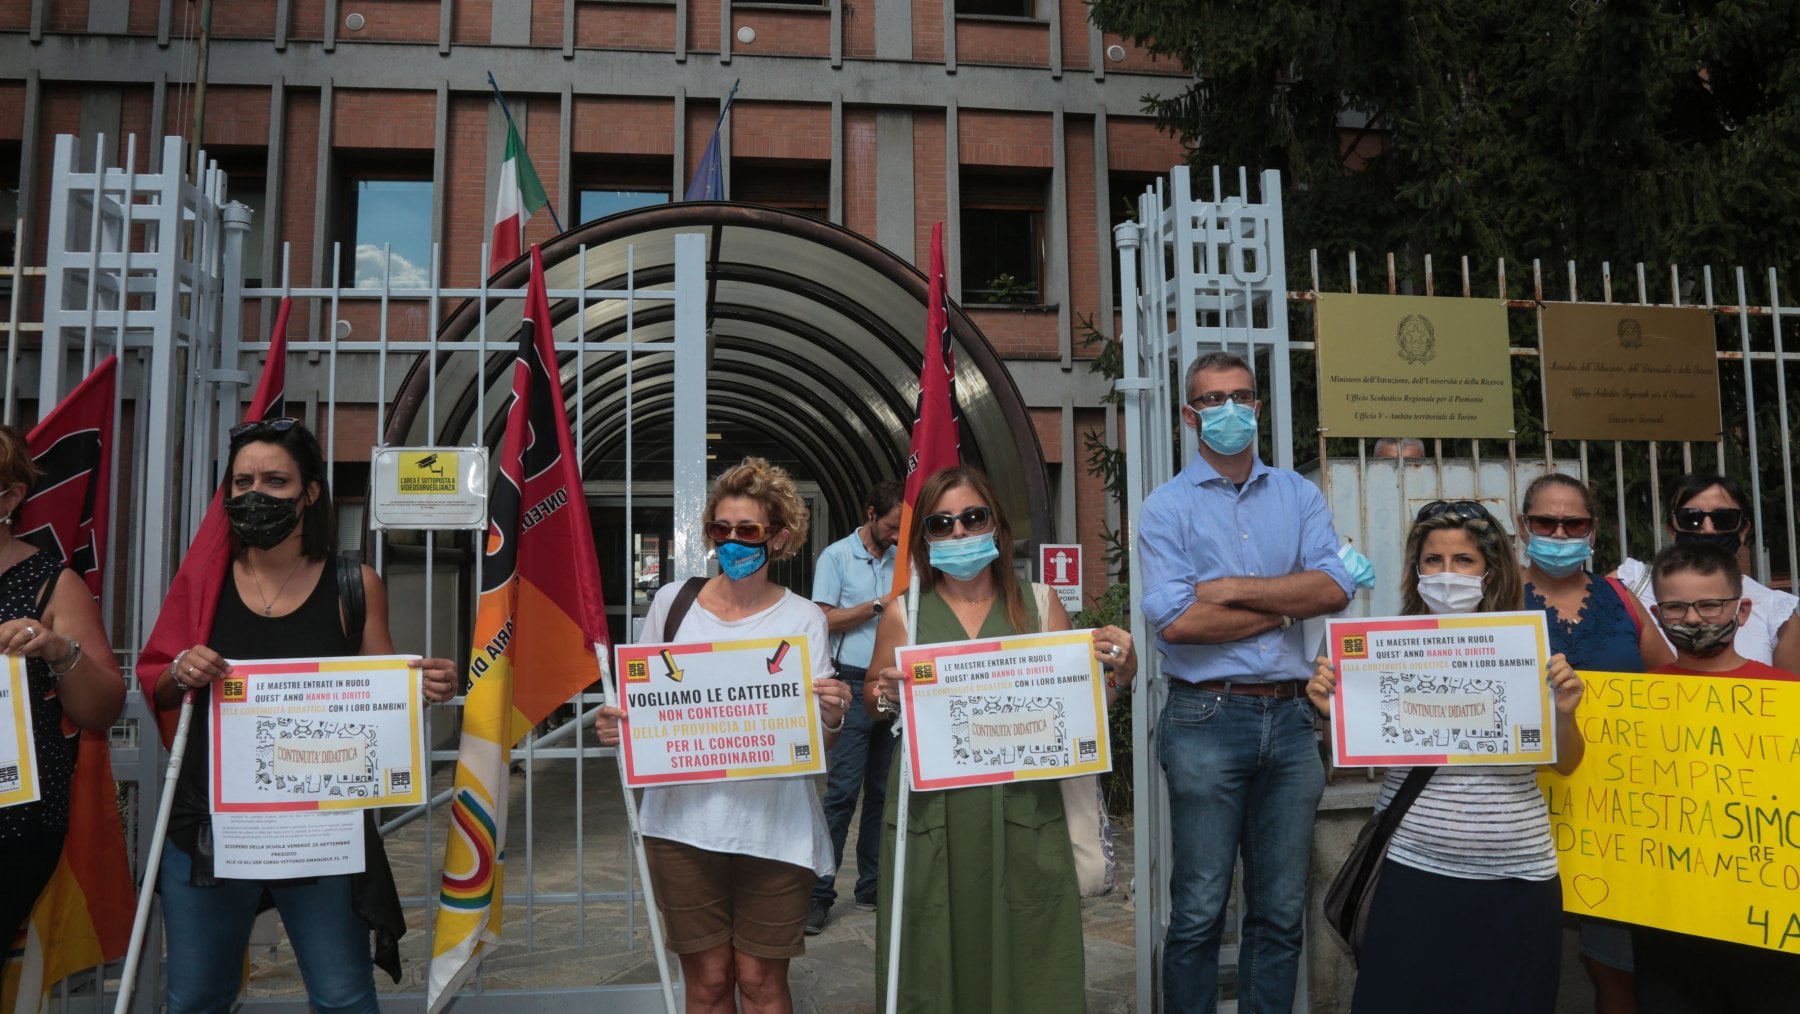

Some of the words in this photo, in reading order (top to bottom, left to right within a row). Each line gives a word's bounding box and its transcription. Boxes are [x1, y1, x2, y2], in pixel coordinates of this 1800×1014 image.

[1346, 394, 1368, 403] Ufficio
[1370, 394, 1401, 402] Scolastico
[1403, 395, 1434, 403] Regionale
[1355, 412, 1377, 421] Ufficio
[1387, 638, 1420, 646] MAESTRE
[1423, 636, 1454, 644] ENTRATE
[1457, 636, 1466, 644] IN
[1468, 635, 1494, 643] RUOLO
[1376, 650, 1401, 659] QUEST'
[1404, 650, 1424, 658] ANNO
[1427, 649, 1452, 657] HANNO
[1455, 648, 1462, 656] IL
[1465, 647, 1495, 656] DIRITTO
[955, 662, 985, 671] MAESTRE
[988, 658, 1016, 667] ENTRATE
[1029, 654, 1052, 663] RUOLO
[1343, 664, 1360, 672] ALLA
[1410, 661, 1449, 670] DIDATTICA
[1452, 660, 1467, 668] CON
[1475, 659, 1496, 668] LORO
[1499, 658, 1535, 667] BAMBINI!
[945, 674, 968, 683] QUEST'
[971, 672, 989, 680] ANNO
[992, 670, 1015, 678] HANNO
[1026, 666, 1054, 676] DIRITTO
[257, 682, 265, 690] LE
[268, 681, 301, 690] MAESTRE
[303, 680, 333, 688] ENTRATE
[346, 679, 370, 687] RUOLO
[914, 689, 930, 697] ALLA
[976, 683, 1012, 692] DIDATTICA
[1015, 680, 1029, 688] CON
[1037, 677, 1055, 686] LORO
[1057, 674, 1089, 684] BAMBINI!
[342, 691, 370, 700] DIRITTO
[628, 690, 700, 707] VOGLIAMO
[707, 689, 723, 702] LE
[728, 682, 800, 701] CATTEDRE
[1585, 678, 1777, 717] NSEGNARE
[222, 708, 238, 716] ALLA
[288, 705, 326, 714] DIDATTICA
[351, 704, 370, 712] LORO
[373, 702, 407, 711] BAMBINI!
[659, 709, 683, 721] NON
[688, 703, 768, 719] CONTEGGIATE
[1448, 702, 1486, 718] DIDATTICA
[633, 726, 668, 740] DELLA
[673, 722, 739, 736] PROVINCIA
[744, 720, 757, 732] DI
[762, 716, 807, 731] TORINO
[1013, 719, 1047, 736] DIDATTICA
[666, 740, 689, 753] PER
[694, 739, 704, 750] IL
[709, 734, 775, 750] CONCORSO
[1661, 725, 1724, 757] UNA
[321, 747, 357, 764] DIDATTICA
[671, 750, 774, 768] STRAORDINARIO!
[1550, 786, 1574, 819] LA
[1586, 786, 1717, 839] MAESTRA
[1556, 822, 1627, 862] DEVE
